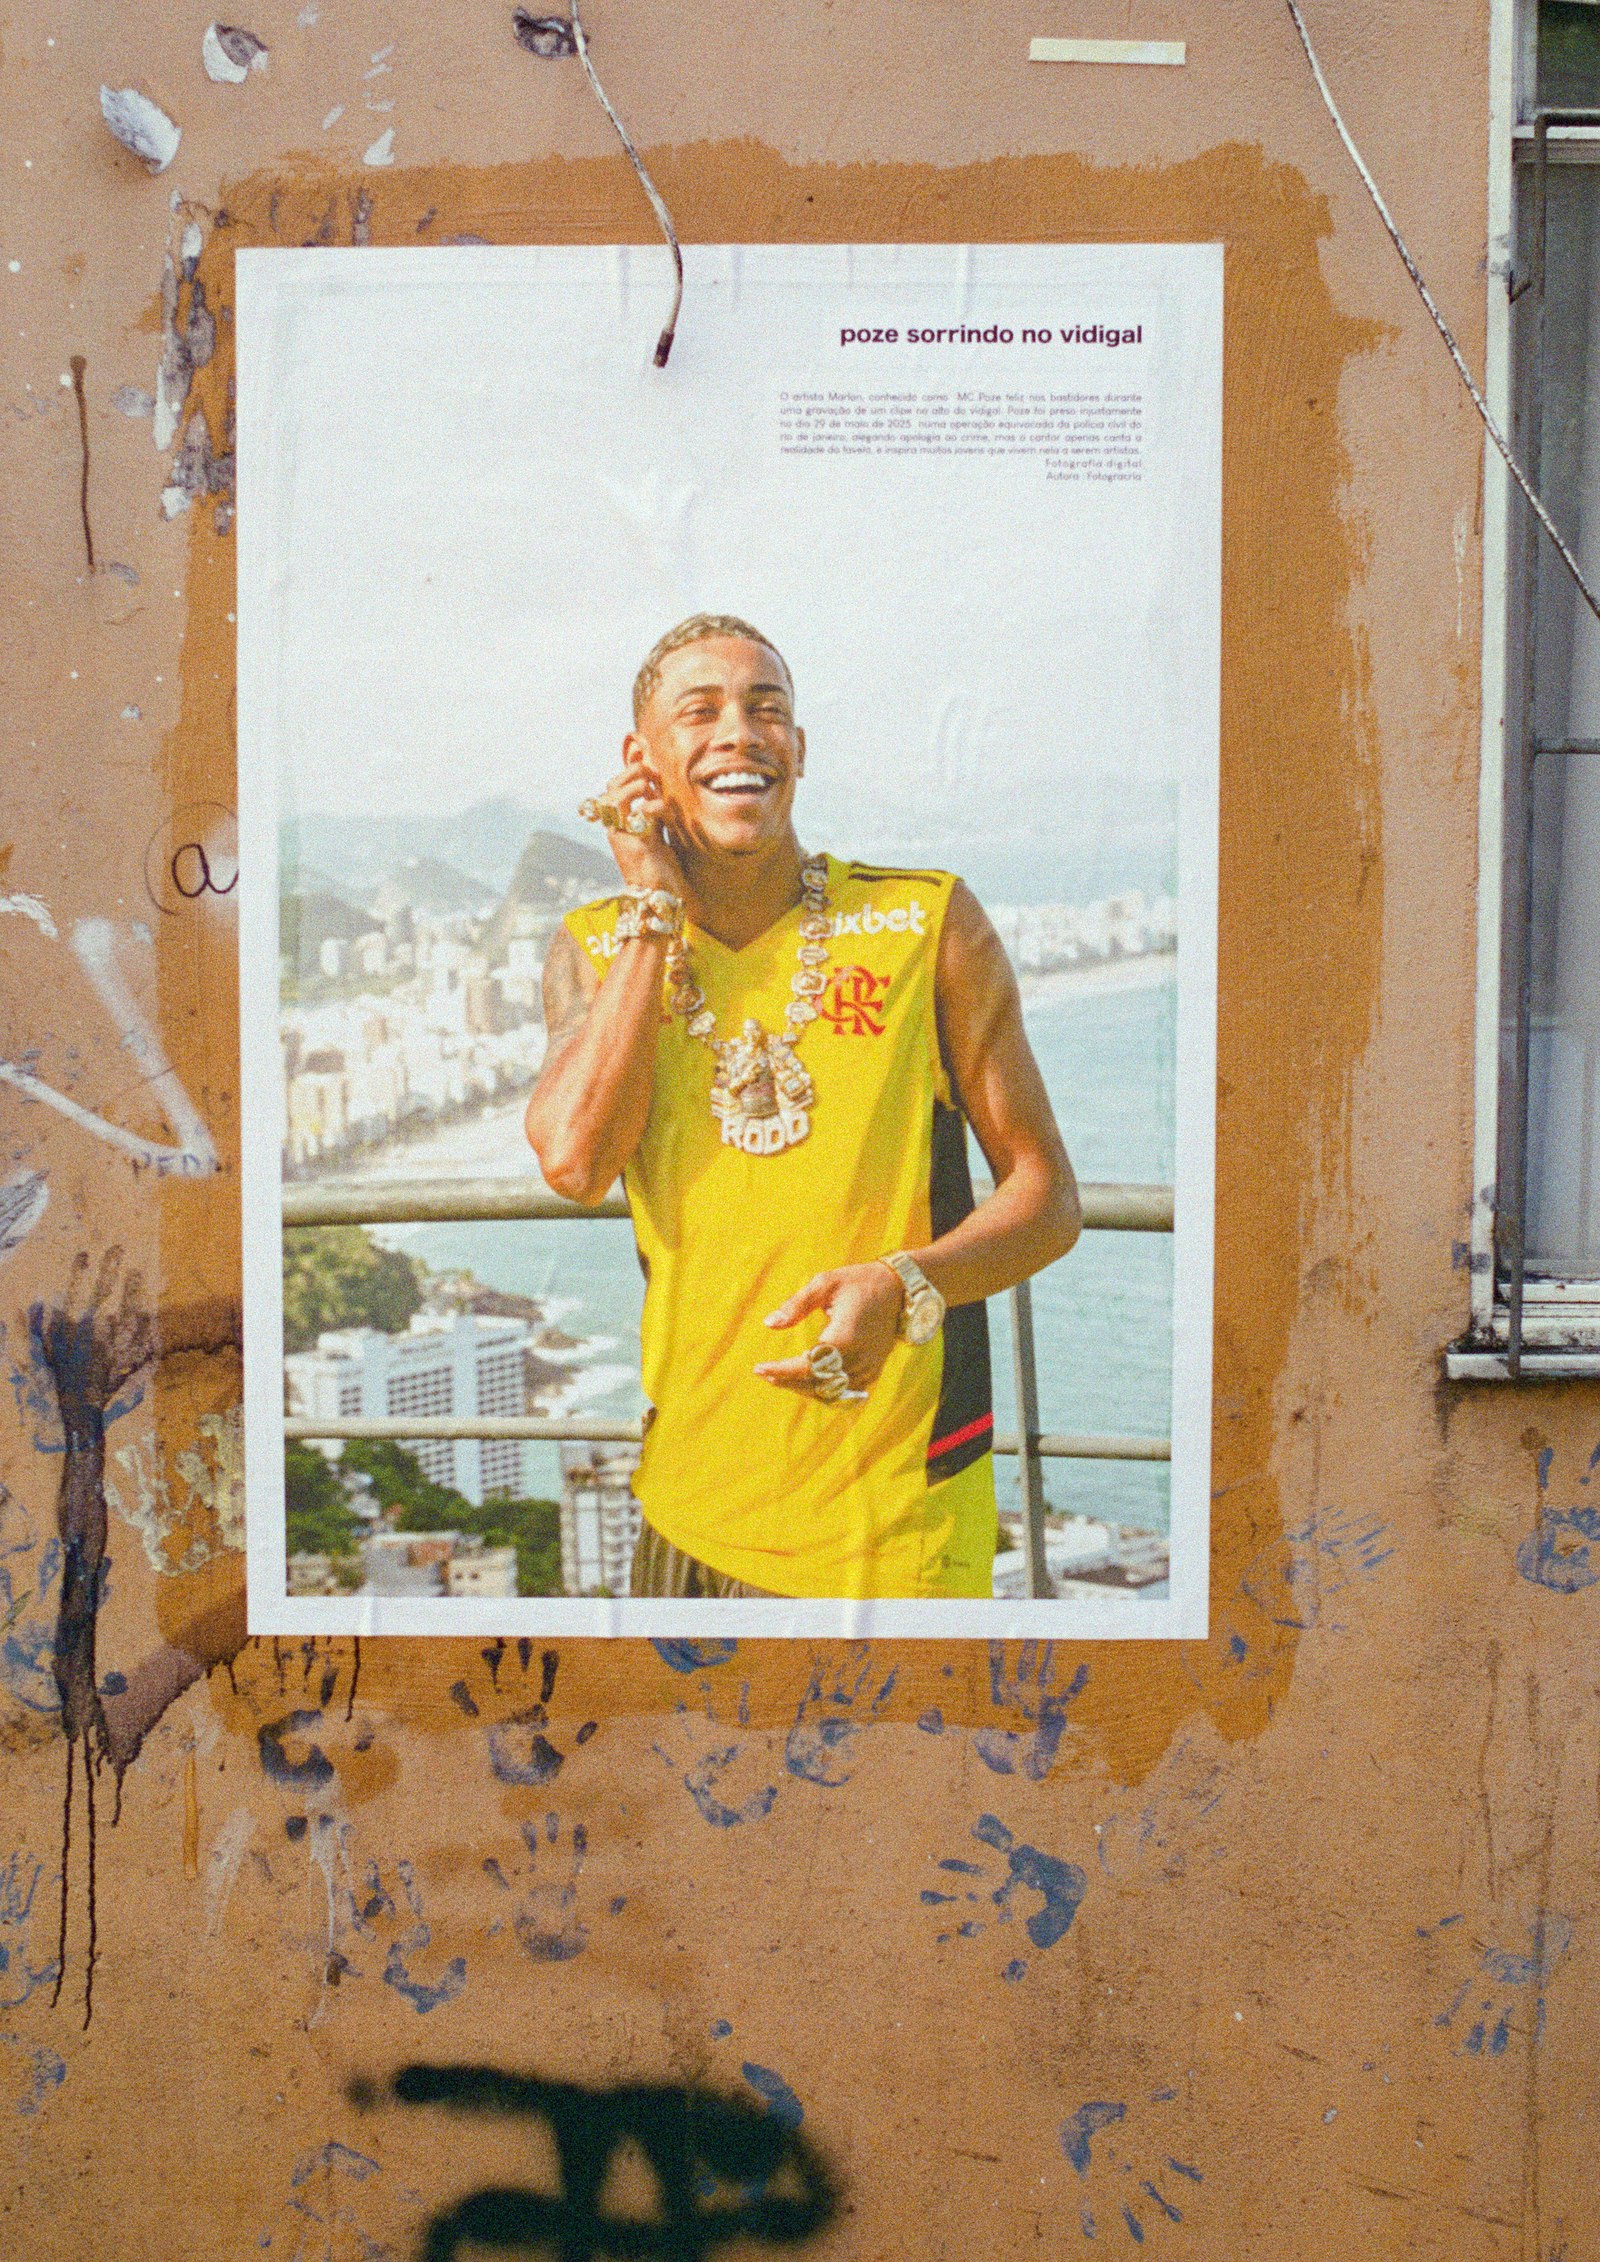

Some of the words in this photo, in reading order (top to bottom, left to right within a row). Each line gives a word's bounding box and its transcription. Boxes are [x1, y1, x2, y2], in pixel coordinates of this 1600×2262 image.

[839, 328, 899, 347] poze
[906, 324, 1015, 344] sorrindo
[1022, 328, 1053, 344] no
[1060, 324, 1143, 347] vidigal
[779, 391, 790, 401] O
[792, 391, 825, 401] artista
[869, 391, 917, 402] conhecido
[923, 394, 948, 402] como
[956, 391, 973, 402] MC
[978, 391, 1002, 402] Poze
[1029, 394, 1046, 402] nos
[1049, 392, 1100, 402] bastidores
[1104, 392, 1143, 402] durante
[780, 407, 803, 415] uma
[805, 405, 851, 417] gravação
[854, 405, 867, 415] de
[870, 407, 886, 415] um
[890, 405, 912, 417] clipe
[916, 407, 929, 415] no
[931, 405, 950, 415] alto
[953, 405, 966, 415] do
[1007, 405, 1031, 416] Poze
[1033, 405, 1046, 416] foi
[1049, 408, 1076, 418] preso
[1080, 405, 1142, 418] injustamente
[779, 420, 792, 428] no
[795, 418, 811, 428] dia
[829, 418, 841, 428] de
[844, 418, 869, 428] maio
[871, 418, 884, 428] de
[918, 420, 947, 428] numa
[949, 418, 995, 431] operação
[998, 418, 1055, 431] equivocada
[1057, 418, 1071, 429] da
[1107, 418, 1127, 429] civil
[1129, 418, 1142, 429] do
[796, 431, 809, 441] de
[899, 431, 942, 444] apologia
[944, 434, 958, 442] ao
[994, 434, 1016, 442] mas
[1019, 434, 1028, 442] o
[1029, 432, 1060, 442] cantor
[1065, 434, 1100, 444] apenas
[1104, 432, 1132, 442] canta
[1136, 434, 1142, 442] a
[779, 444, 826, 454] realidade
[827, 444, 841, 454] da
[877, 446, 883, 454] e
[884, 444, 918, 457] inspira
[919, 444, 953, 455] muitos
[954, 444, 985, 457] jovens
[987, 447, 1006, 457] que
[1008, 444, 1037, 455] vivem
[1062, 447, 1069, 455] a
[1070, 447, 1101, 455] serem
[1044, 457, 1103, 470] Fotografia
[1104, 457, 1143, 470] digital
[831, 900, 926, 937] ixbet
